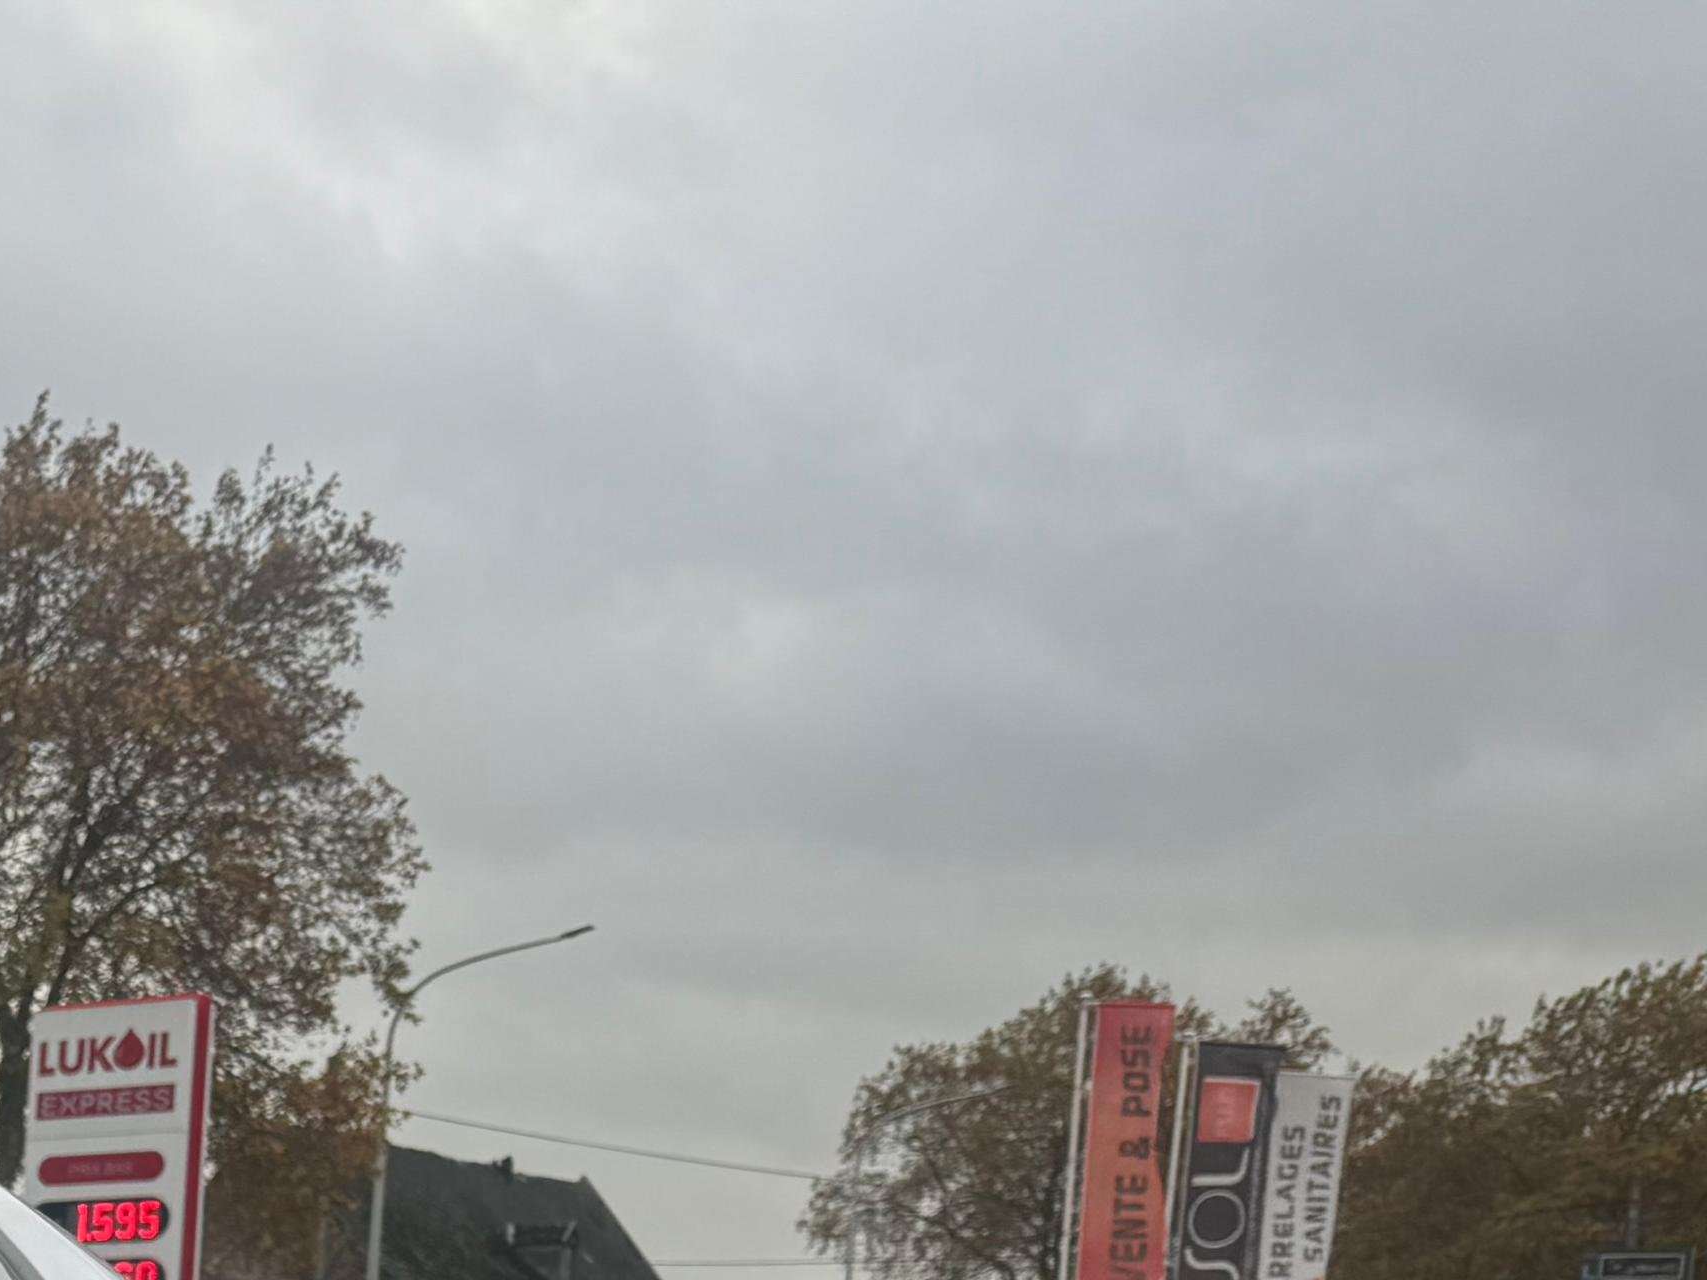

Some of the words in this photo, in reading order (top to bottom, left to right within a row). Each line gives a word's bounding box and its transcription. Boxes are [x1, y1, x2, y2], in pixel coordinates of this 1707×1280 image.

[39, 1029, 177, 1077] LUKOIL
[1120, 1023, 1154, 1119] POSE
[40, 1088, 174, 1119] EXPRESS
[1119, 1137, 1150, 1160] &
[1302, 1094, 1343, 1264] SANITAIRES
